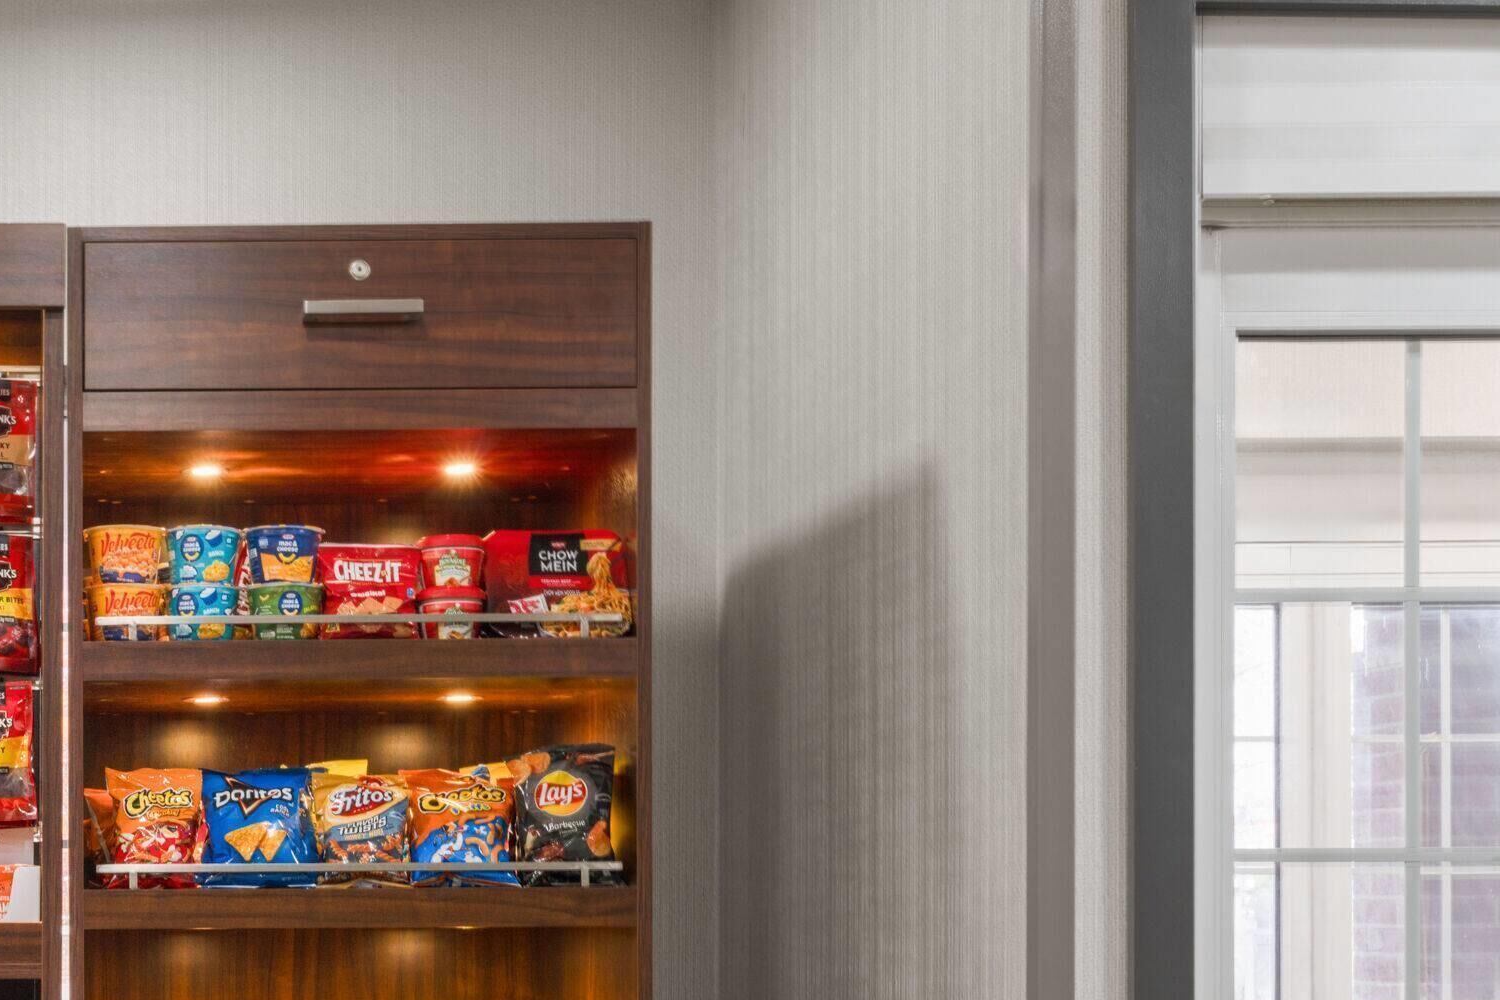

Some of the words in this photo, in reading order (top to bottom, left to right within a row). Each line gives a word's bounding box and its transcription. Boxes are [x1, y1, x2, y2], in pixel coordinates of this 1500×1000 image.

[101, 532, 156, 552] Velveeta
[538, 550, 579, 561] CHOW
[540, 561, 578, 572] MEIN
[105, 589, 159, 611] Velveeta
[124, 788, 194, 818] Cheetos
[214, 787, 294, 807] Doritos
[329, 786, 394, 815] Fritos
[538, 781, 584, 808] Lay's
[338, 817, 387, 835] TWISTS
[548, 820, 586, 831] Barbecue
